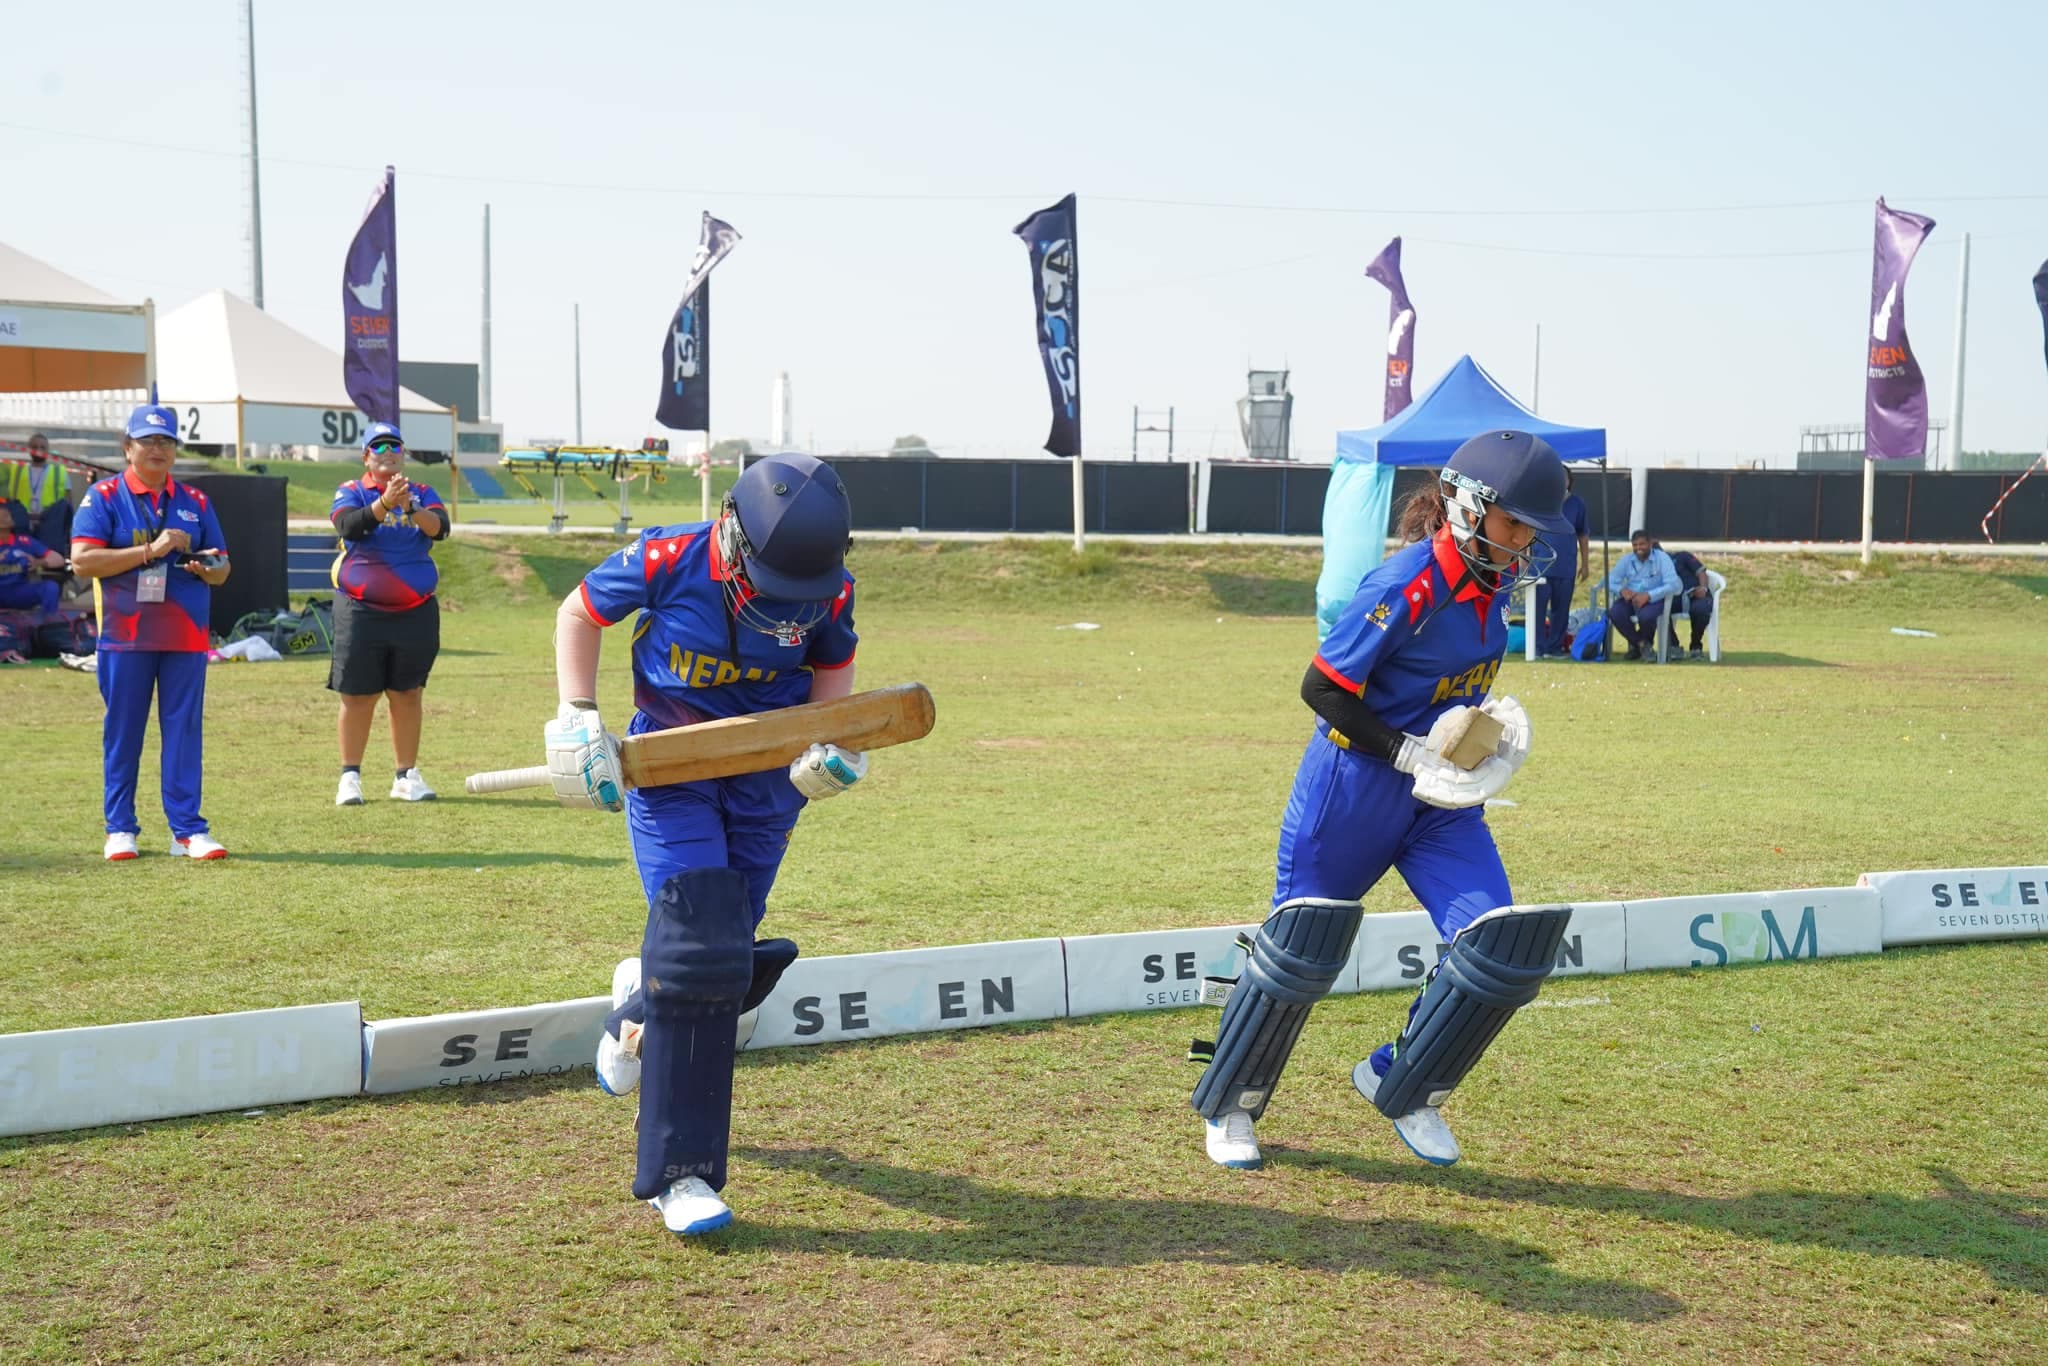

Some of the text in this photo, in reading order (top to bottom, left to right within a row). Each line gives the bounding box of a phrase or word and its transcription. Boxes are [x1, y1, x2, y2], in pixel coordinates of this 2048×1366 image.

[322, 411, 374, 445] SD-
[1689, 905, 1818, 968] SDM
[1939, 912, 2048, 927] SEVEN DISTRI
